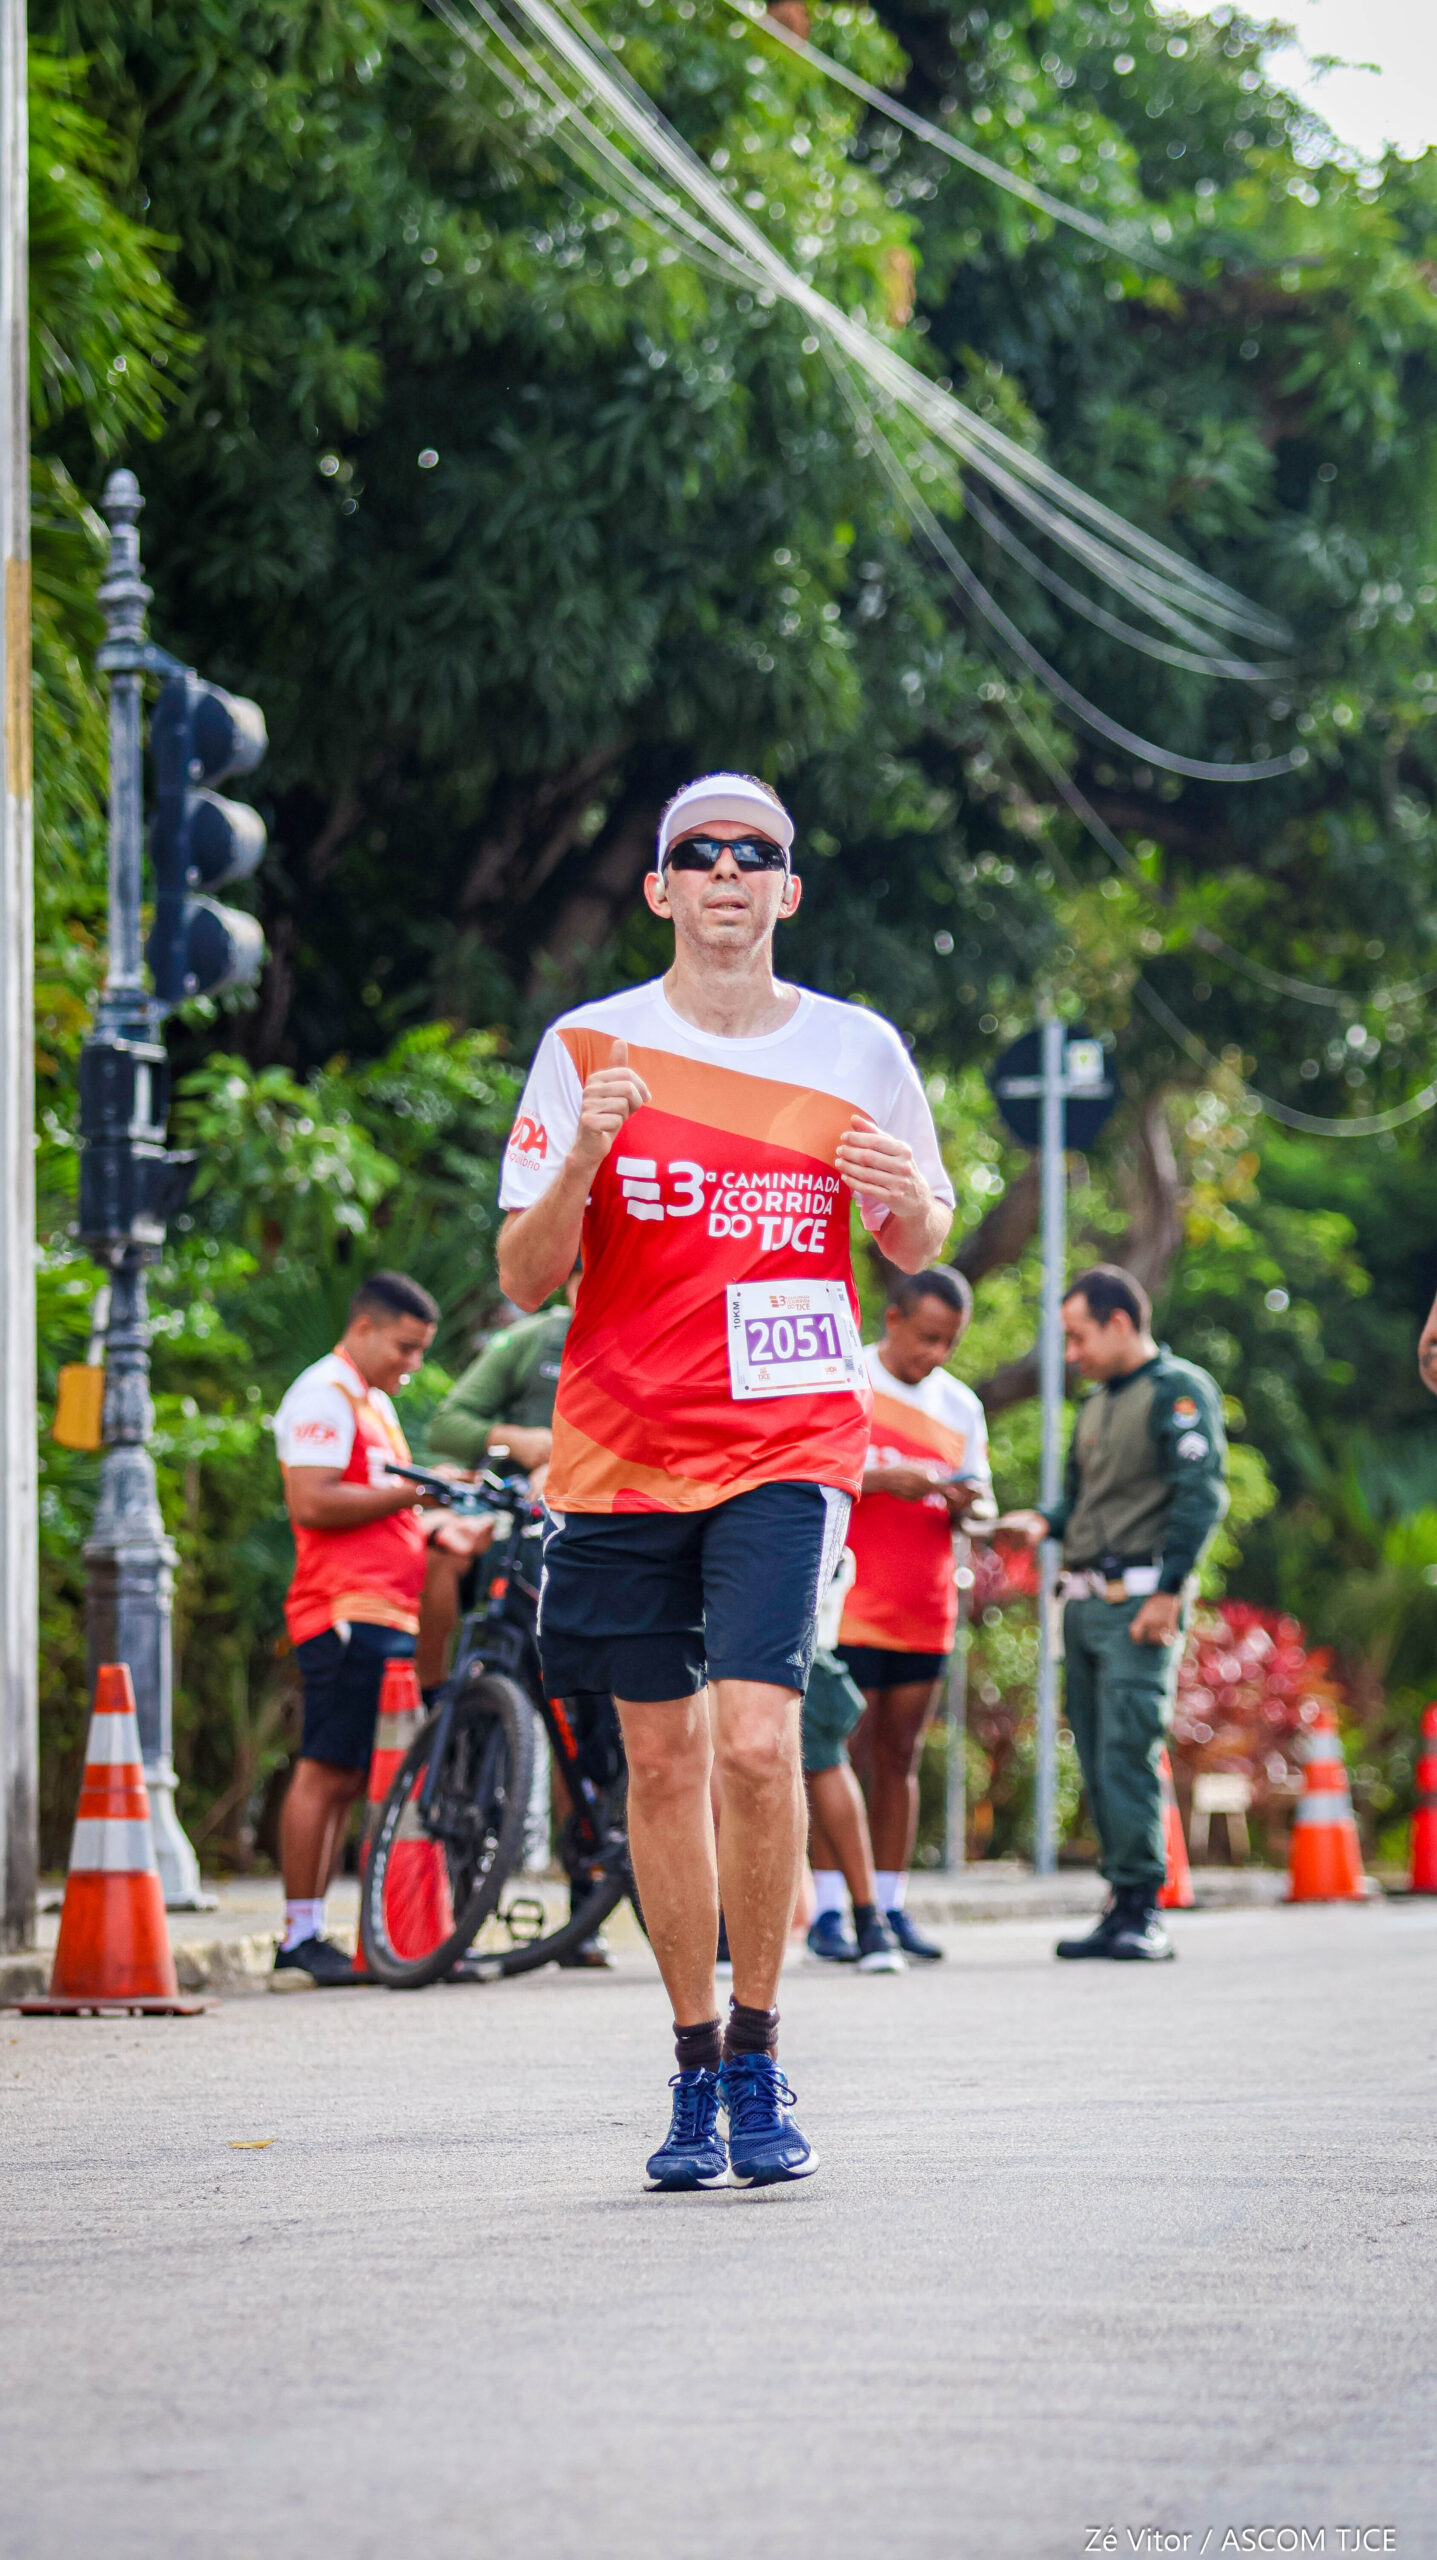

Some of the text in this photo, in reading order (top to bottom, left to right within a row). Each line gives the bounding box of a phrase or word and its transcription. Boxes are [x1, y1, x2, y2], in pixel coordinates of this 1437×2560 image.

[722, 1172, 840, 1194] CAMINHADA
[708, 1213, 828, 1254] DO TJCE
[732, 1301, 741, 1330] 10KM
[748, 1316, 836, 1362] 2051
